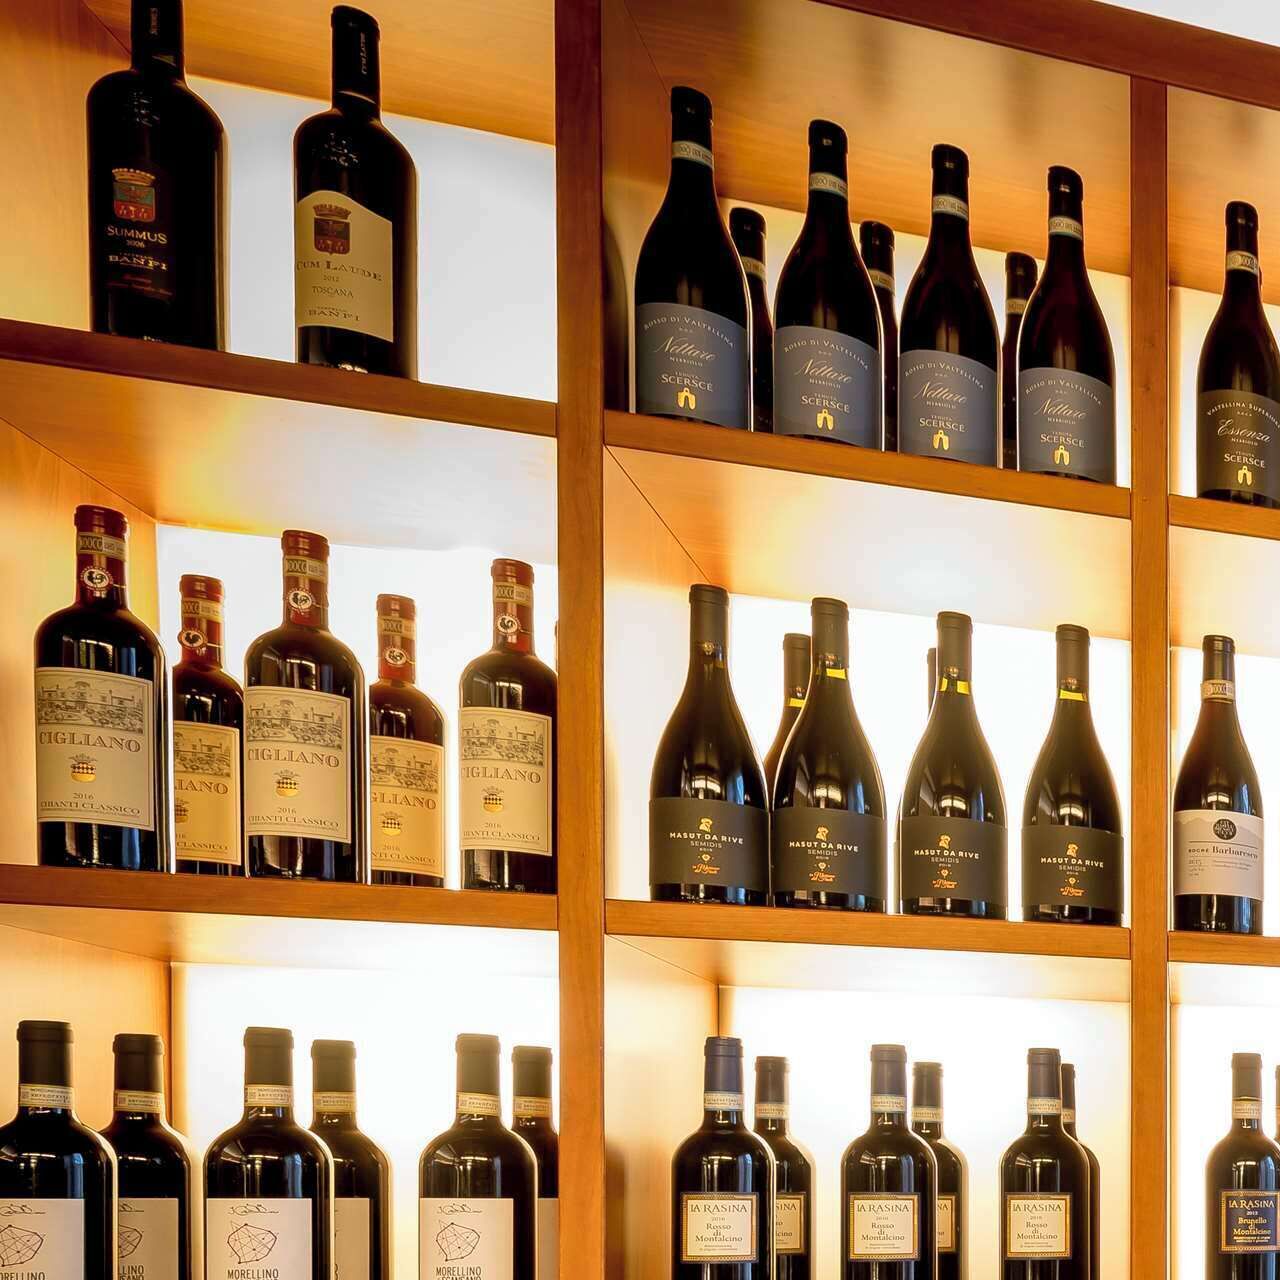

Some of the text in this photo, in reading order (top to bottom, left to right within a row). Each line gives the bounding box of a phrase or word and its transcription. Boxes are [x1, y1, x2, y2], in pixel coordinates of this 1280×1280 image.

[107, 224, 167, 244] SUMMUS
[296, 260, 383, 281] CUM LAUDE
[311, 285, 354, 298] TOSCANA
[653, 335, 716, 360] Nettare
[794, 359, 853, 383] Nettare
[1217, 418, 1272, 443] Essenza
[39, 731, 141, 753] CIGLIANO
[248, 748, 340, 768] CIGLIANO
[72, 792, 94, 800] 2016
[81, 802, 141, 816] CLASSICO
[284, 817, 340, 829] CLASSICO
[669, 831, 744, 845] MASUT DA RIVE
[689, 840, 723, 849] SEMIDIS
[789, 840, 818, 848] MASUT
[836, 843, 859, 853] RIVE
[807, 849, 839, 857] SEMIDIS
[914, 849, 941, 857] MASUT
[958, 851, 980, 860] RIVE
[1212, 845, 1258, 860] Barbaresco
[1040, 857, 1069, 865] MASUT
[1085, 859, 1104, 868] RIVE
[703, 1203, 747, 1215] RASINA
[869, 1203, 909, 1214] RASINA
[1024, 1203, 1062, 1213] RASINA
[1240, 1199, 1275, 1210] RASINA
[871, 1222, 895, 1230] Rosso
[1238, 1217, 1267, 1225] Brunello
[706, 1223, 731, 1231] Rosso
[1233, 1228, 1272, 1236] Montalcino
[695, 1234, 743, 1243] Montalcino
[861, 1233, 905, 1241] Montalcino
[227, 1268, 279, 1279] MORELLINO
[435, 1266, 482, 1276] MORELLINO
